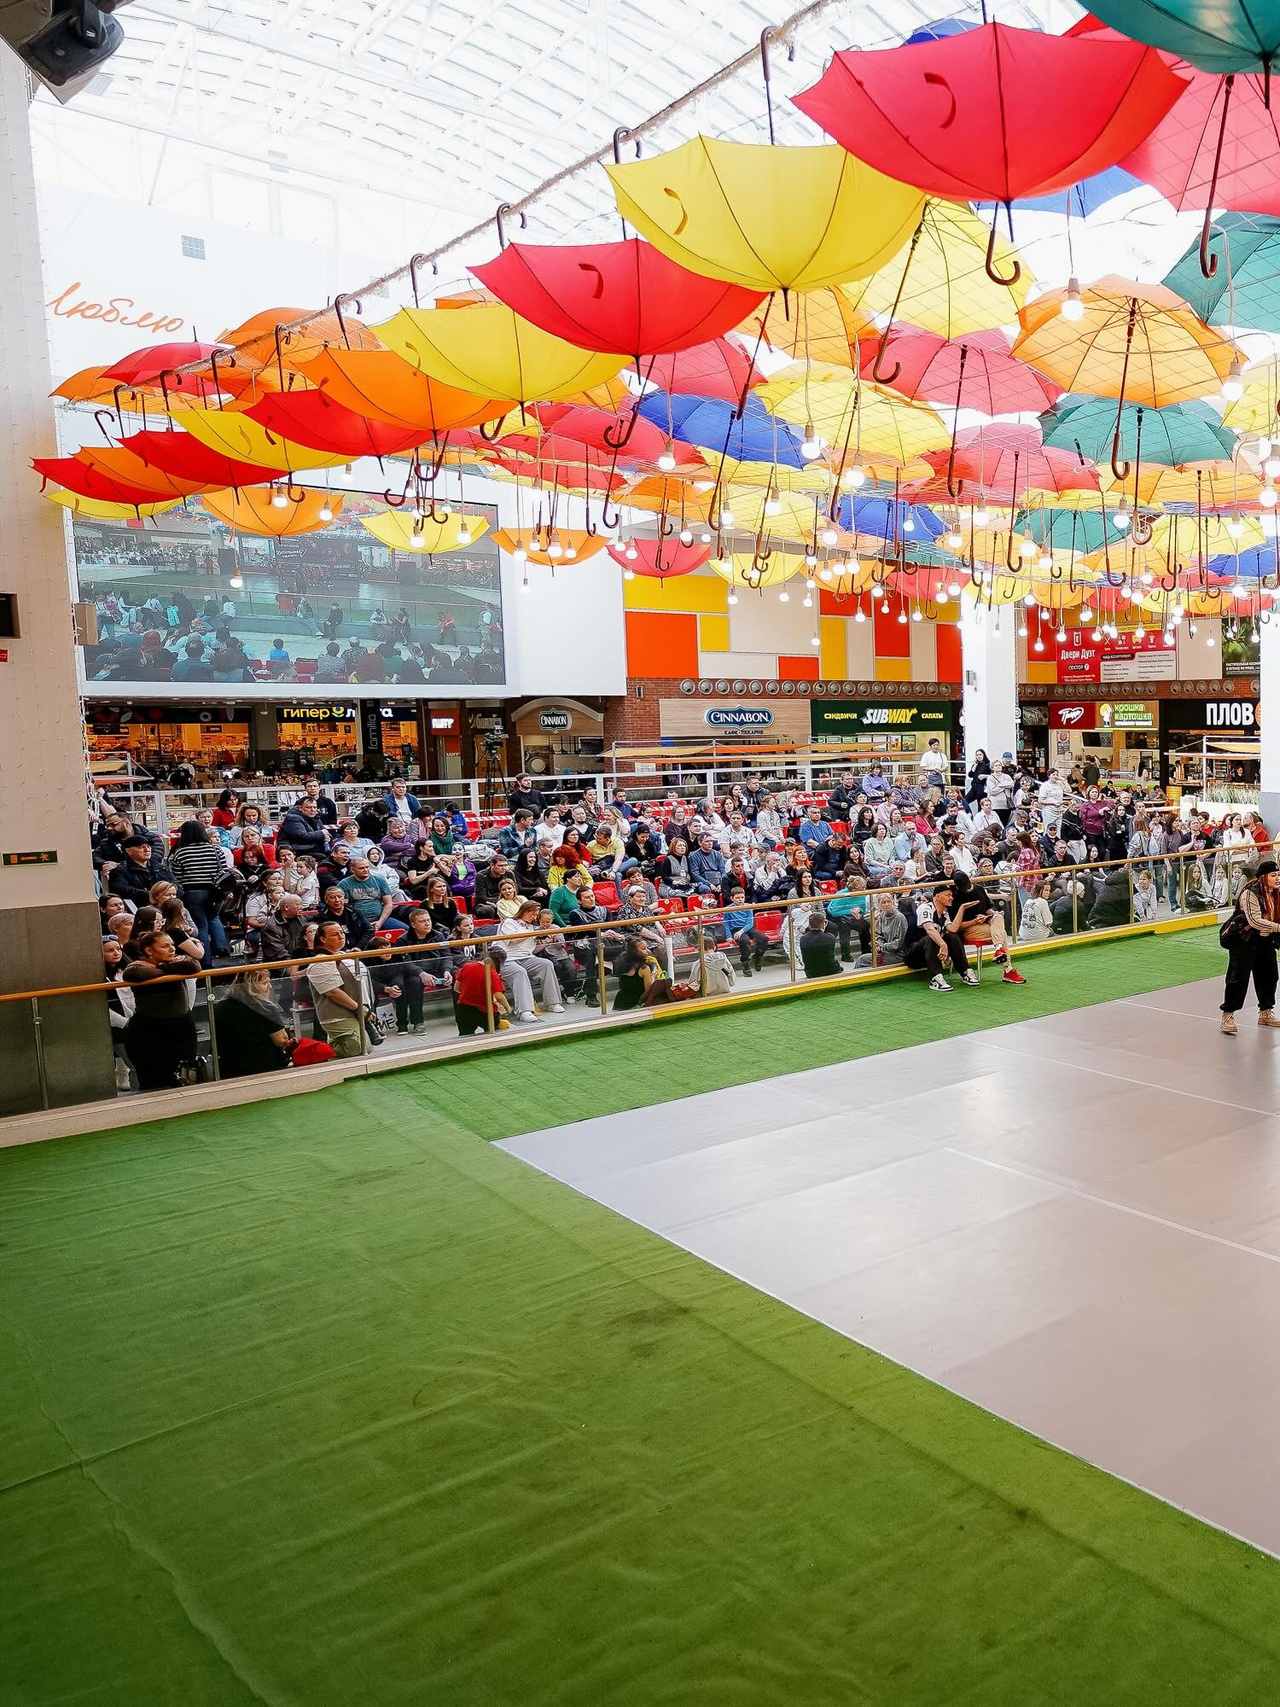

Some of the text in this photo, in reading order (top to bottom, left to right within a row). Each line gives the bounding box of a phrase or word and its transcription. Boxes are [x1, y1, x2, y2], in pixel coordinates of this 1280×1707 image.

[1061, 648, 1095, 660] Двери Дуэт
[283, 708, 330, 720] гипер
[1114, 703, 1145, 713] крошка
[1206, 703, 1254, 725] ПЛОВ
[541, 715, 567, 725] CINNABON
[710, 711, 769, 723] CINNABON
[823, 712, 858, 720] СЭНДВИЧИ
[863, 707, 918, 724] SUBWAY
[1114, 712, 1153, 721] картошка
[366, 713, 378, 750] familia
